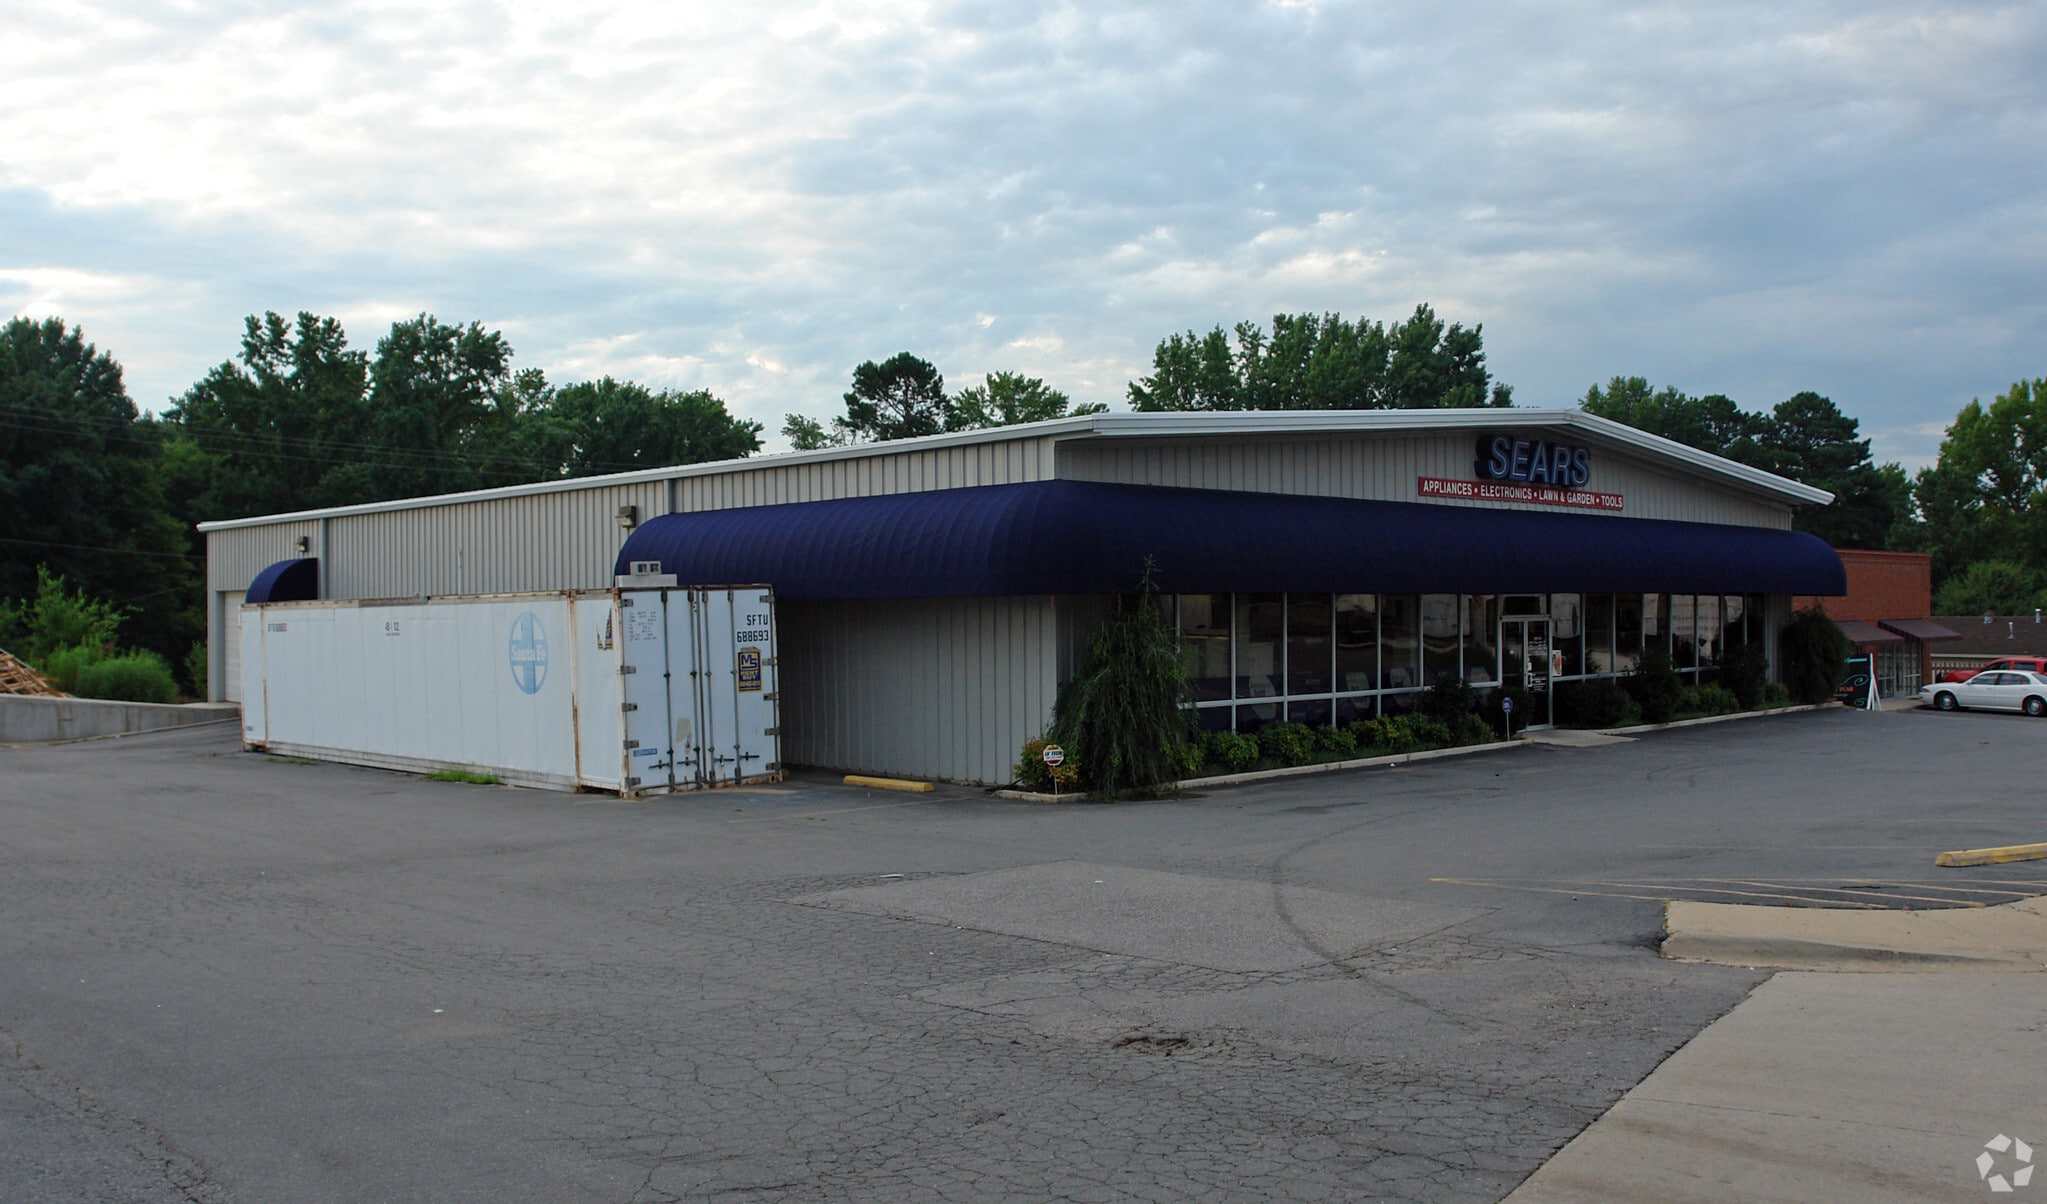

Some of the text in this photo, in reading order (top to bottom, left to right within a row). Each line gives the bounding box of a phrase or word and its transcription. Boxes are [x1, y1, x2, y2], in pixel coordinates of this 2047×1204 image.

[1486, 435, 1591, 488] SEARS
[1423, 480, 1623, 508] APPLIANCES ELECTRONICS LAWN & GARDEN TOOLS
[746, 614, 769, 626] SFTU
[736, 630, 769, 643] 688693
